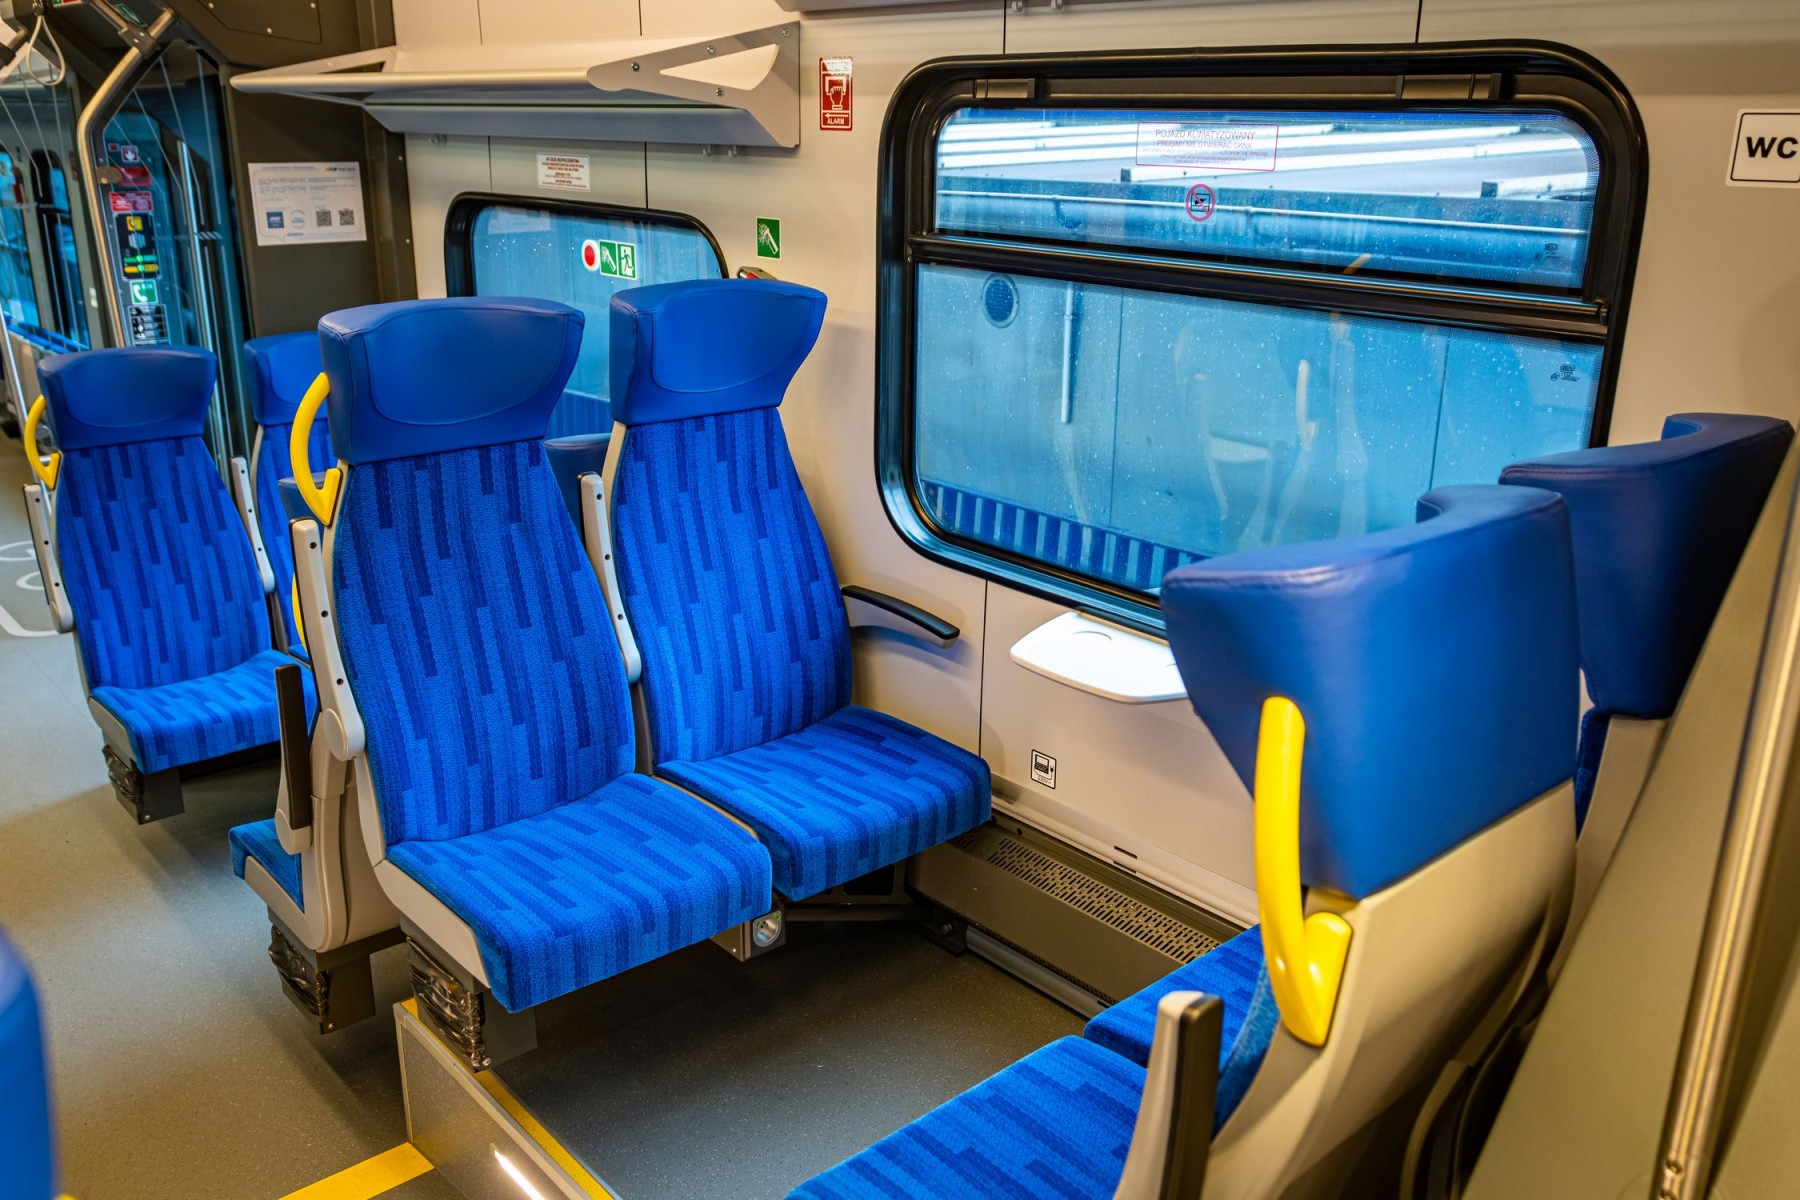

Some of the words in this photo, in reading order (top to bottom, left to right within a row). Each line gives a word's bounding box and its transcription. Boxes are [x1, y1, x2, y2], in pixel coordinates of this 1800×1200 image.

[827, 117, 845, 125] ALARM
[1155, 129, 1186, 138] POJAZD
[1187, 130, 1256, 140] KLIMATYZOWANY
[1156, 140, 1185, 148] PROSIMY
[1186, 140, 1196, 148] NIE
[1233, 142, 1252, 150] OKNA
[1746, 136, 1799, 159] WC
